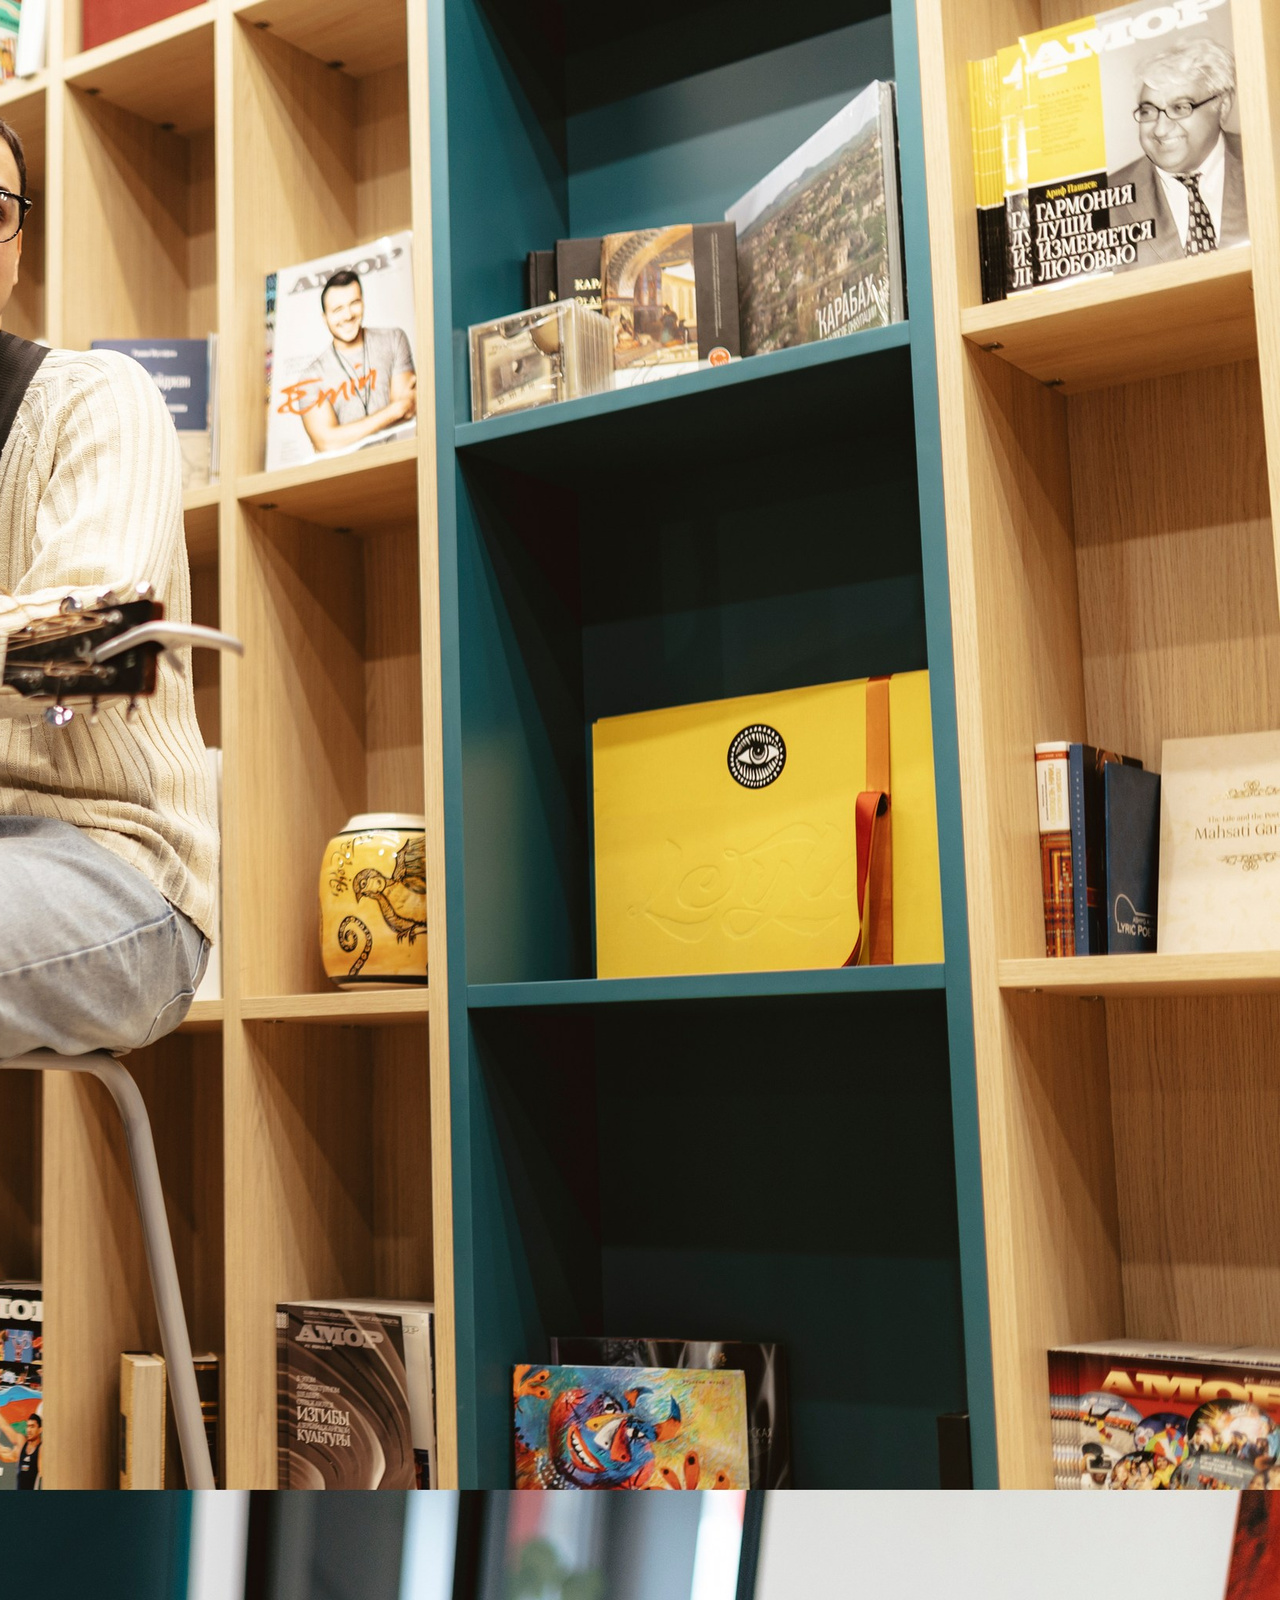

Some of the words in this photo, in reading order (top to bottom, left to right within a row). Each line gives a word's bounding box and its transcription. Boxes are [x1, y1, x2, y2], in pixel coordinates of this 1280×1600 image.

[1035, 184, 1134, 222] ГАРМОНИЯ
[1046, 184, 1067, 200] Ариф
[1036, 213, 1093, 243] ДУШИ
[1037, 220, 1153, 262] ИЗМЕРЯЕТСЯ
[1038, 244, 1136, 282] ЛЮБОВЬЮ
[817, 273, 875, 339] КАРАБАХ
[277, 362, 378, 416] Emin
[1194, 822, 1250, 841] Mahsati
[1116, 921, 1136, 936] LYRIC
[295, 1324, 384, 1349] АМОР
[296, 1405, 350, 1426] ИЗГИБЫ
[296, 1428, 351, 1447] КУЛЬТУРЫ
